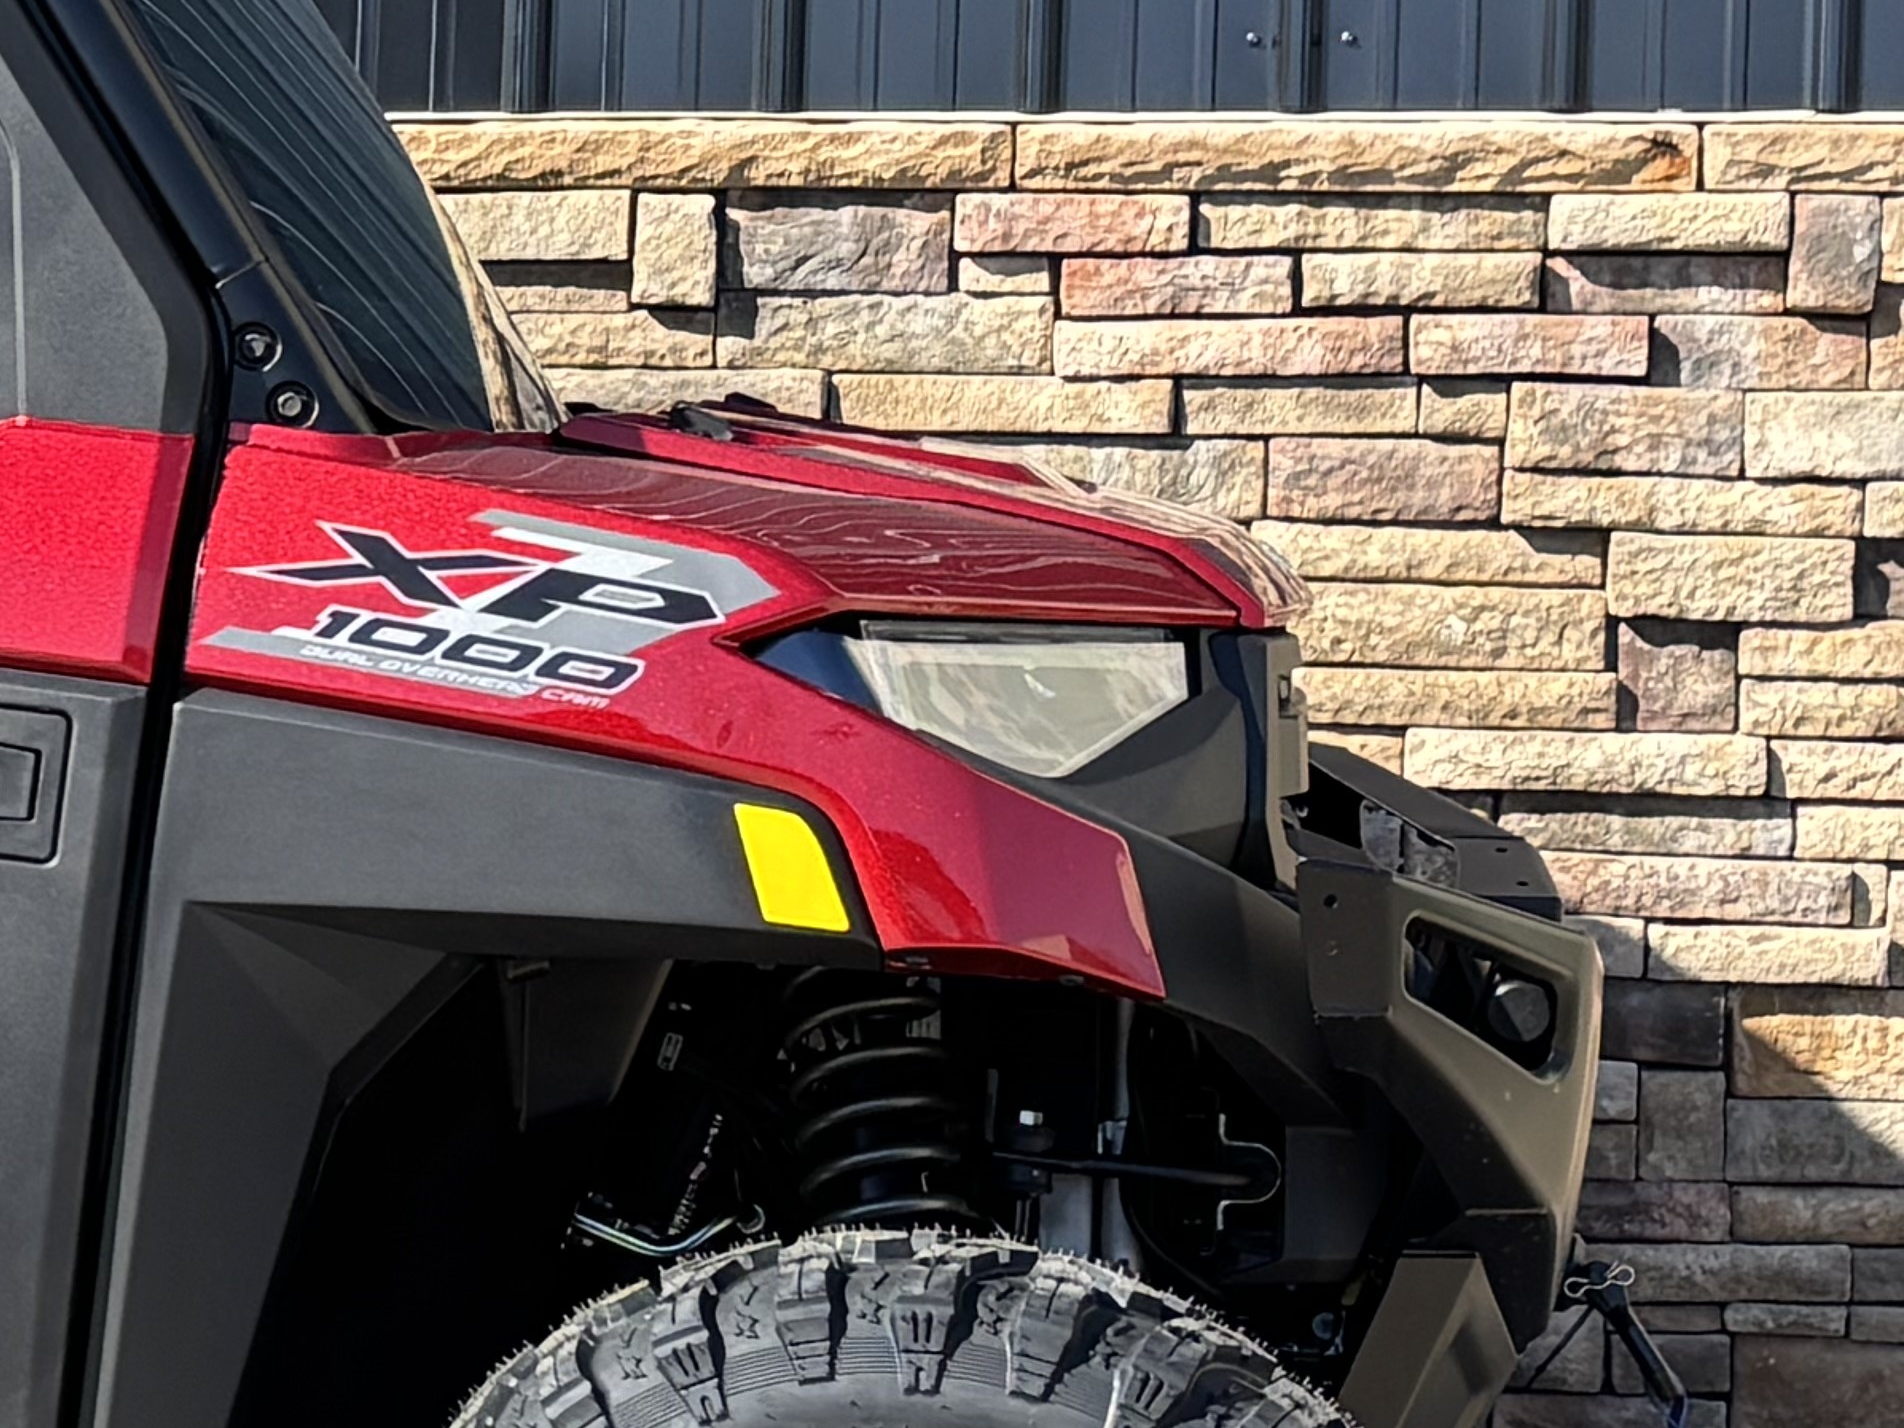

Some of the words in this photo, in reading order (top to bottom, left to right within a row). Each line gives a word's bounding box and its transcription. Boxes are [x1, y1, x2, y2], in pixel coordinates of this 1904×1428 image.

[222, 520, 727, 628] XP
[299, 644, 374, 667] DUAL
[541, 687, 610, 709] CAM
[312, 606, 645, 695] 1000
